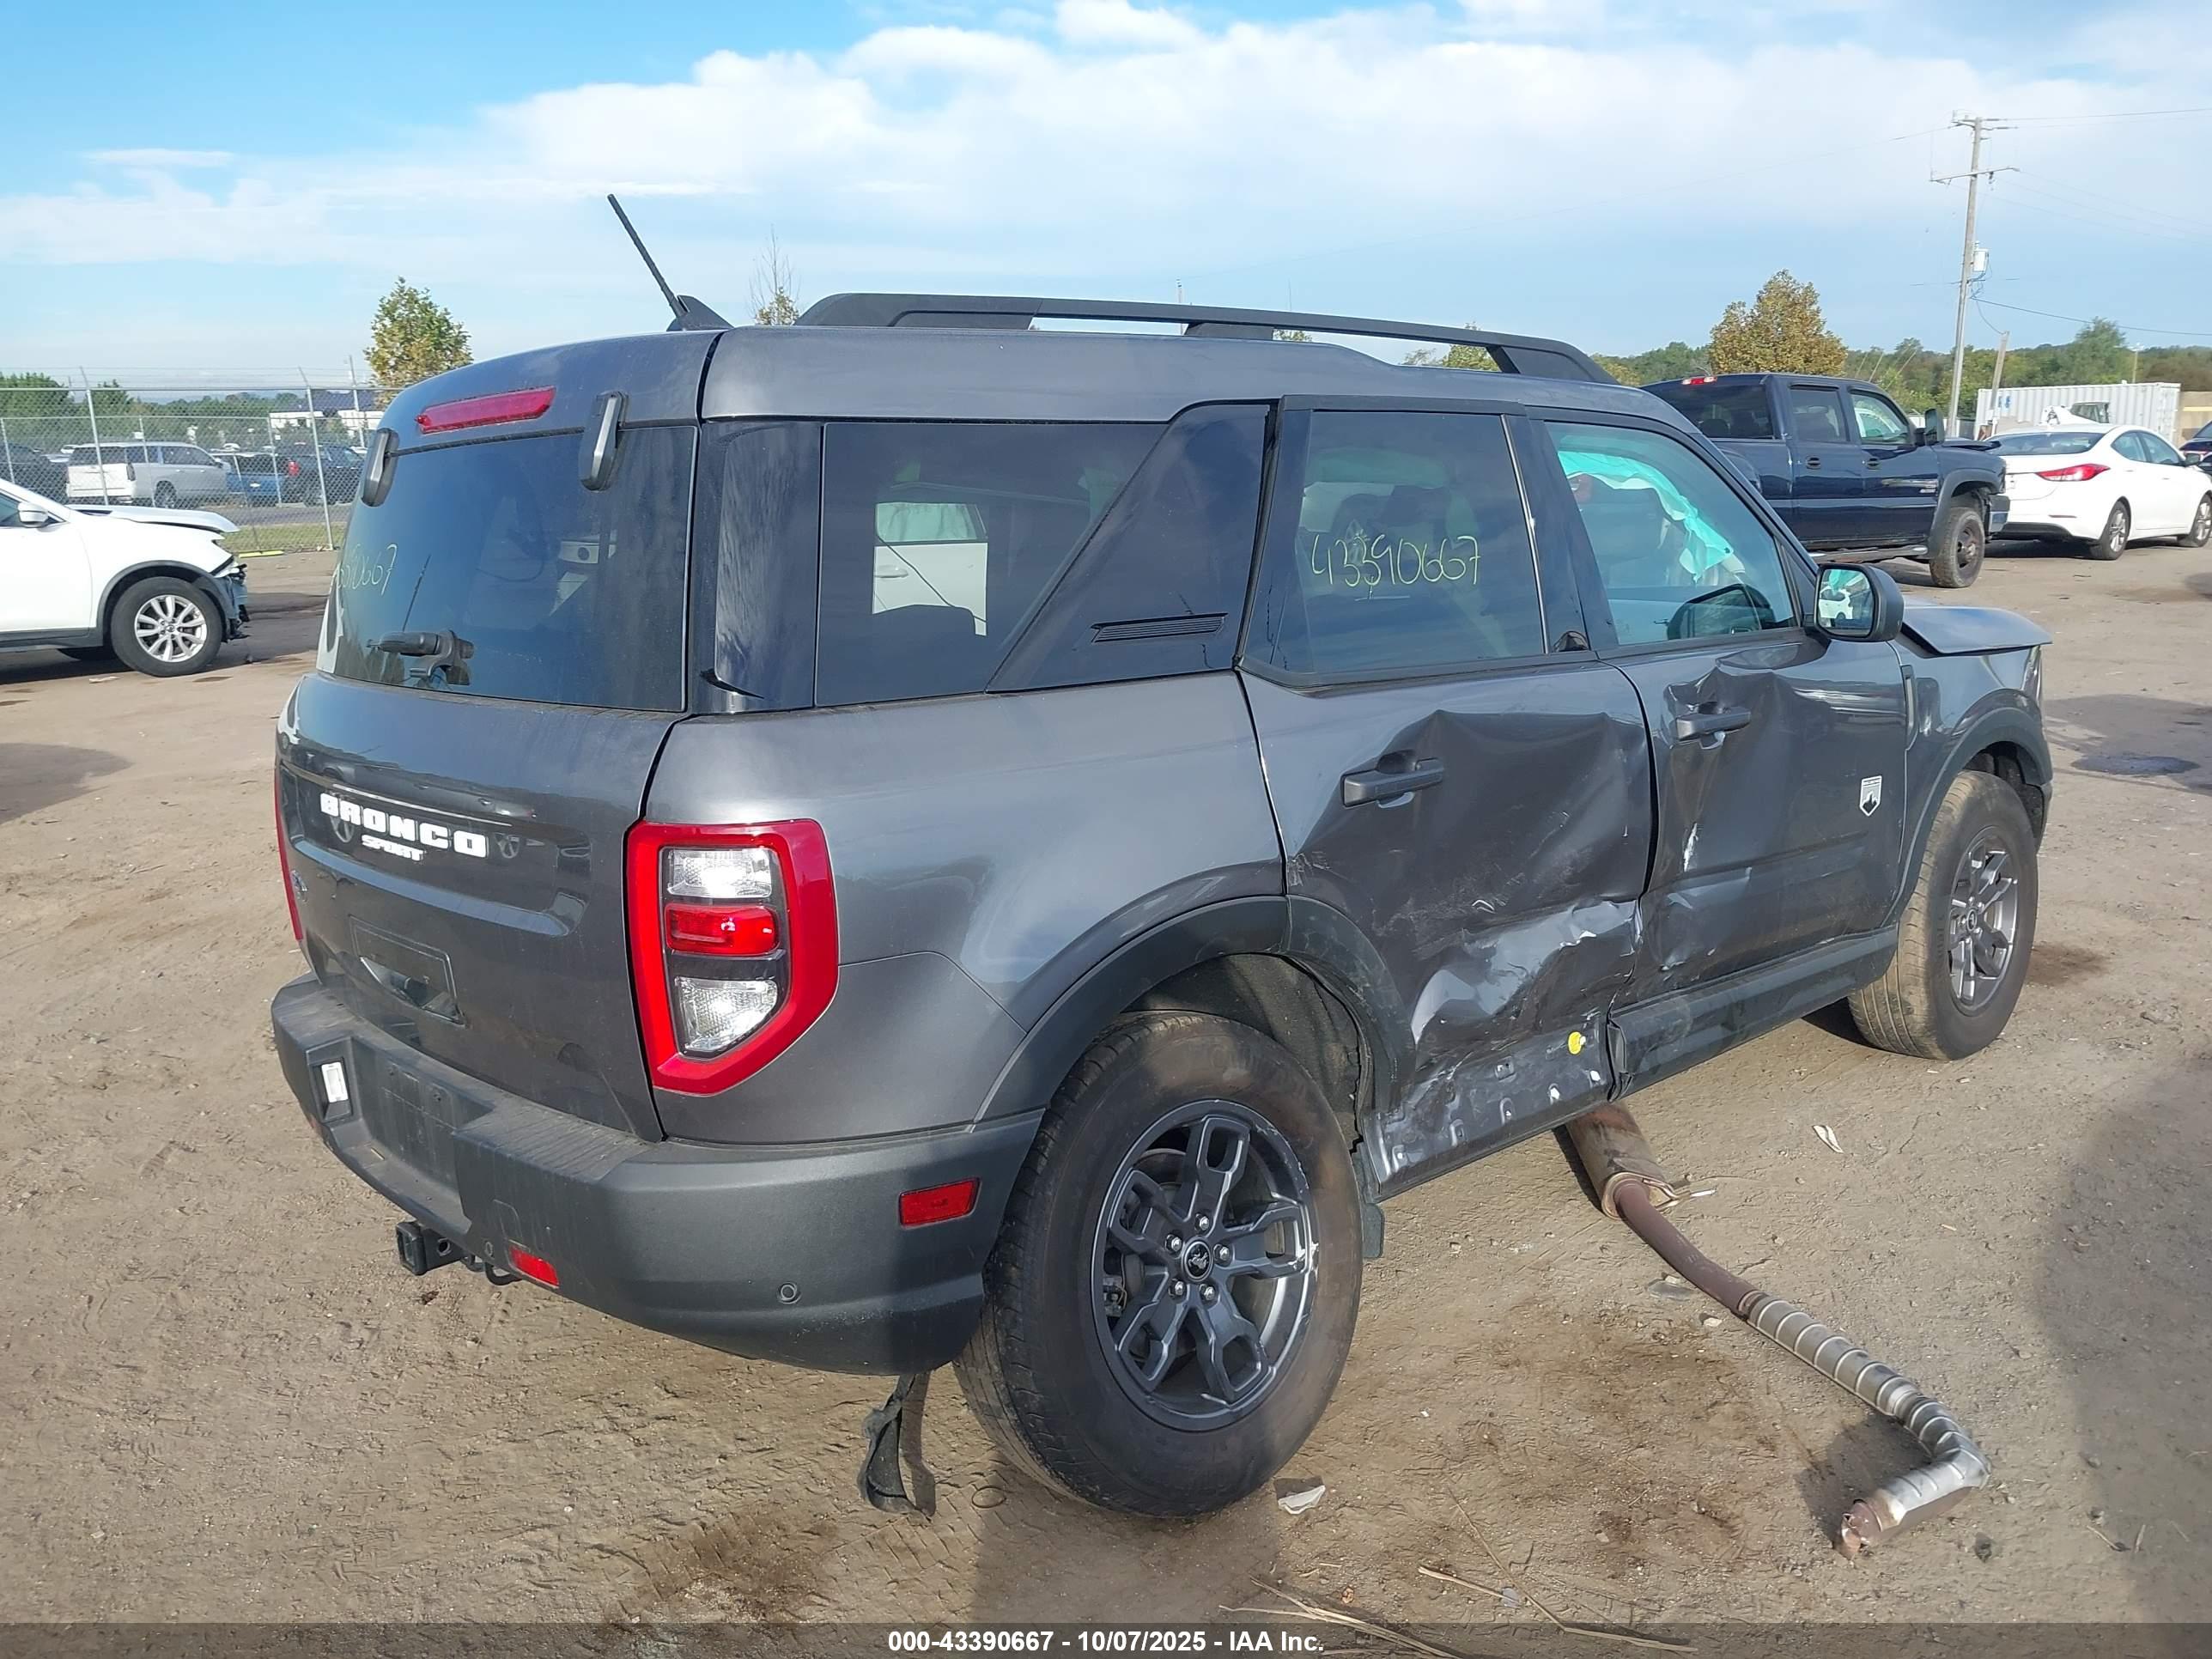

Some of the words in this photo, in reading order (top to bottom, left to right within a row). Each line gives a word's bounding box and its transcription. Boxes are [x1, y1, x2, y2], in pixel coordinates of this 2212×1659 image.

[1311, 534, 1480, 586] 43390667
[320, 793, 488, 858] BRONCO
[362, 834, 425, 861] SPORT
